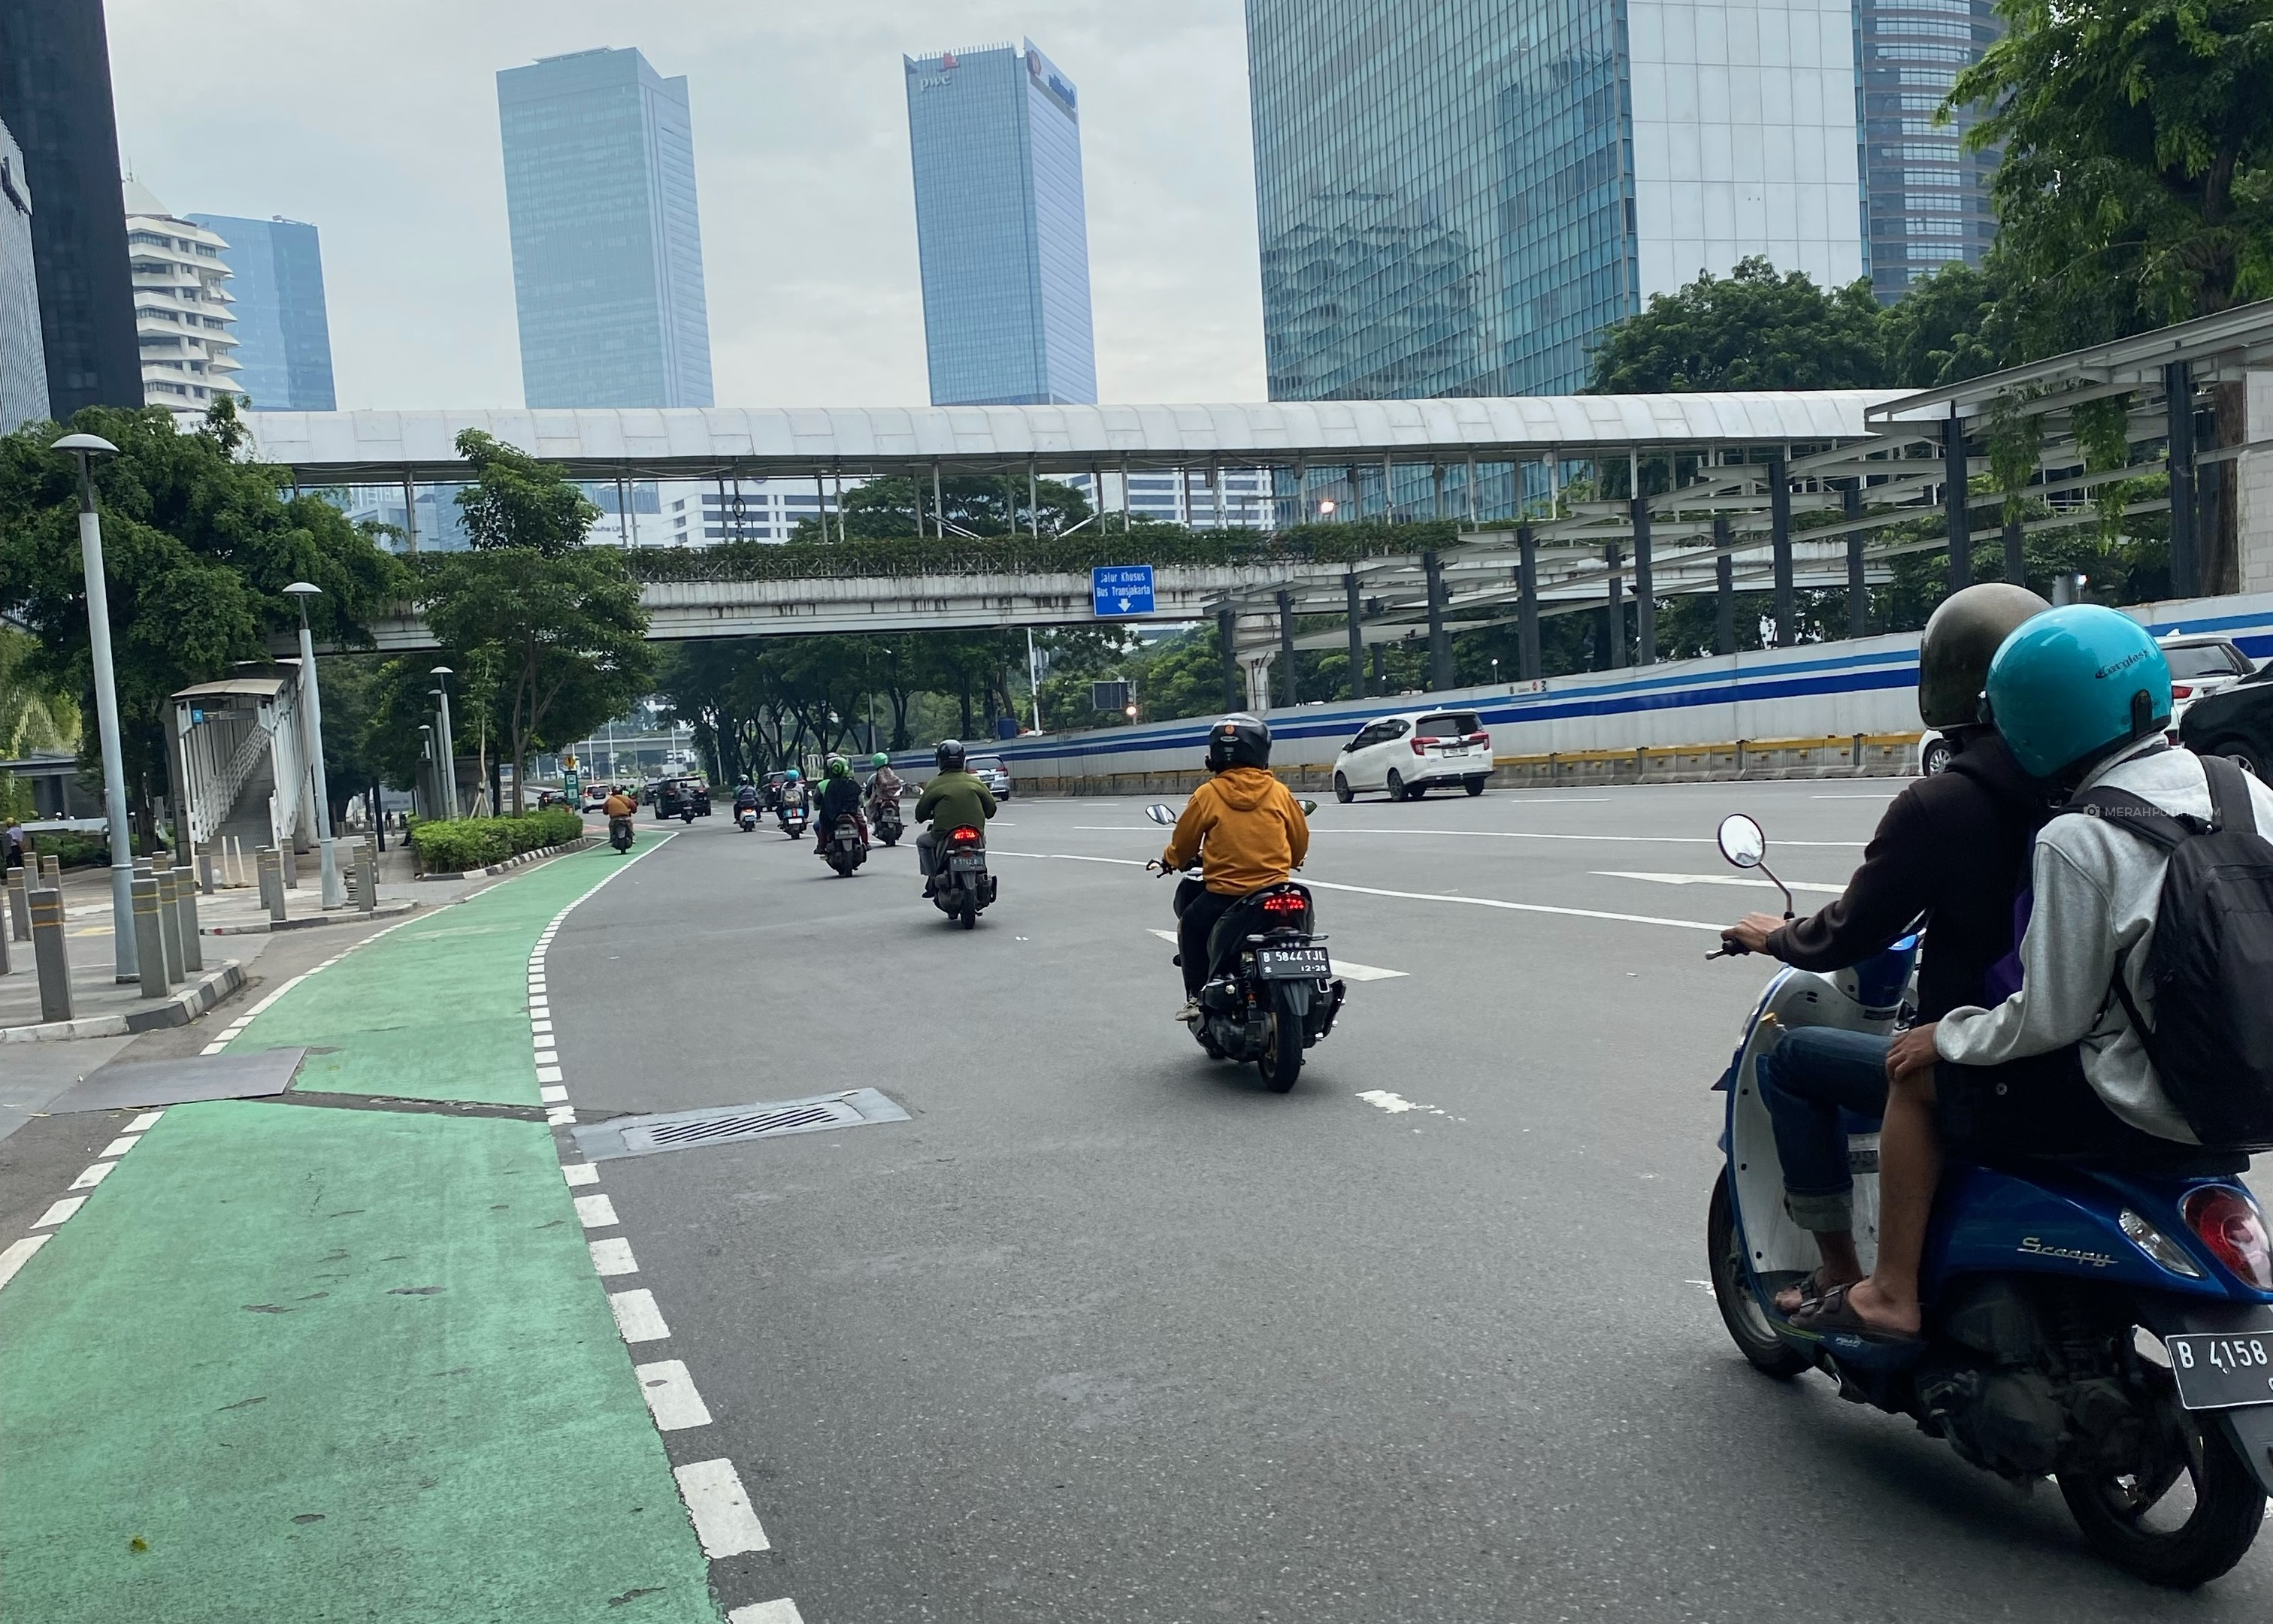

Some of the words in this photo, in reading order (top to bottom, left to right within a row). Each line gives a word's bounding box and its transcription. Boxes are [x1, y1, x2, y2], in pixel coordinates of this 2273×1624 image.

[920, 76, 951, 92] pwc
[1100, 573, 1117, 583] Jalur
[1121, 571, 1145, 582] Khusus
[1096, 587, 1108, 597] Bus
[1112, 585, 1151, 598] Transjakarta
[1263, 951, 1270, 963] B
[1275, 951, 1303, 962] 5844
[1305, 950, 1326, 961] TJL
[2016, 1236, 2120, 1268] Scoopy
[2177, 1341, 2195, 1368] B
[2210, 1340, 2268, 1368] 4158
